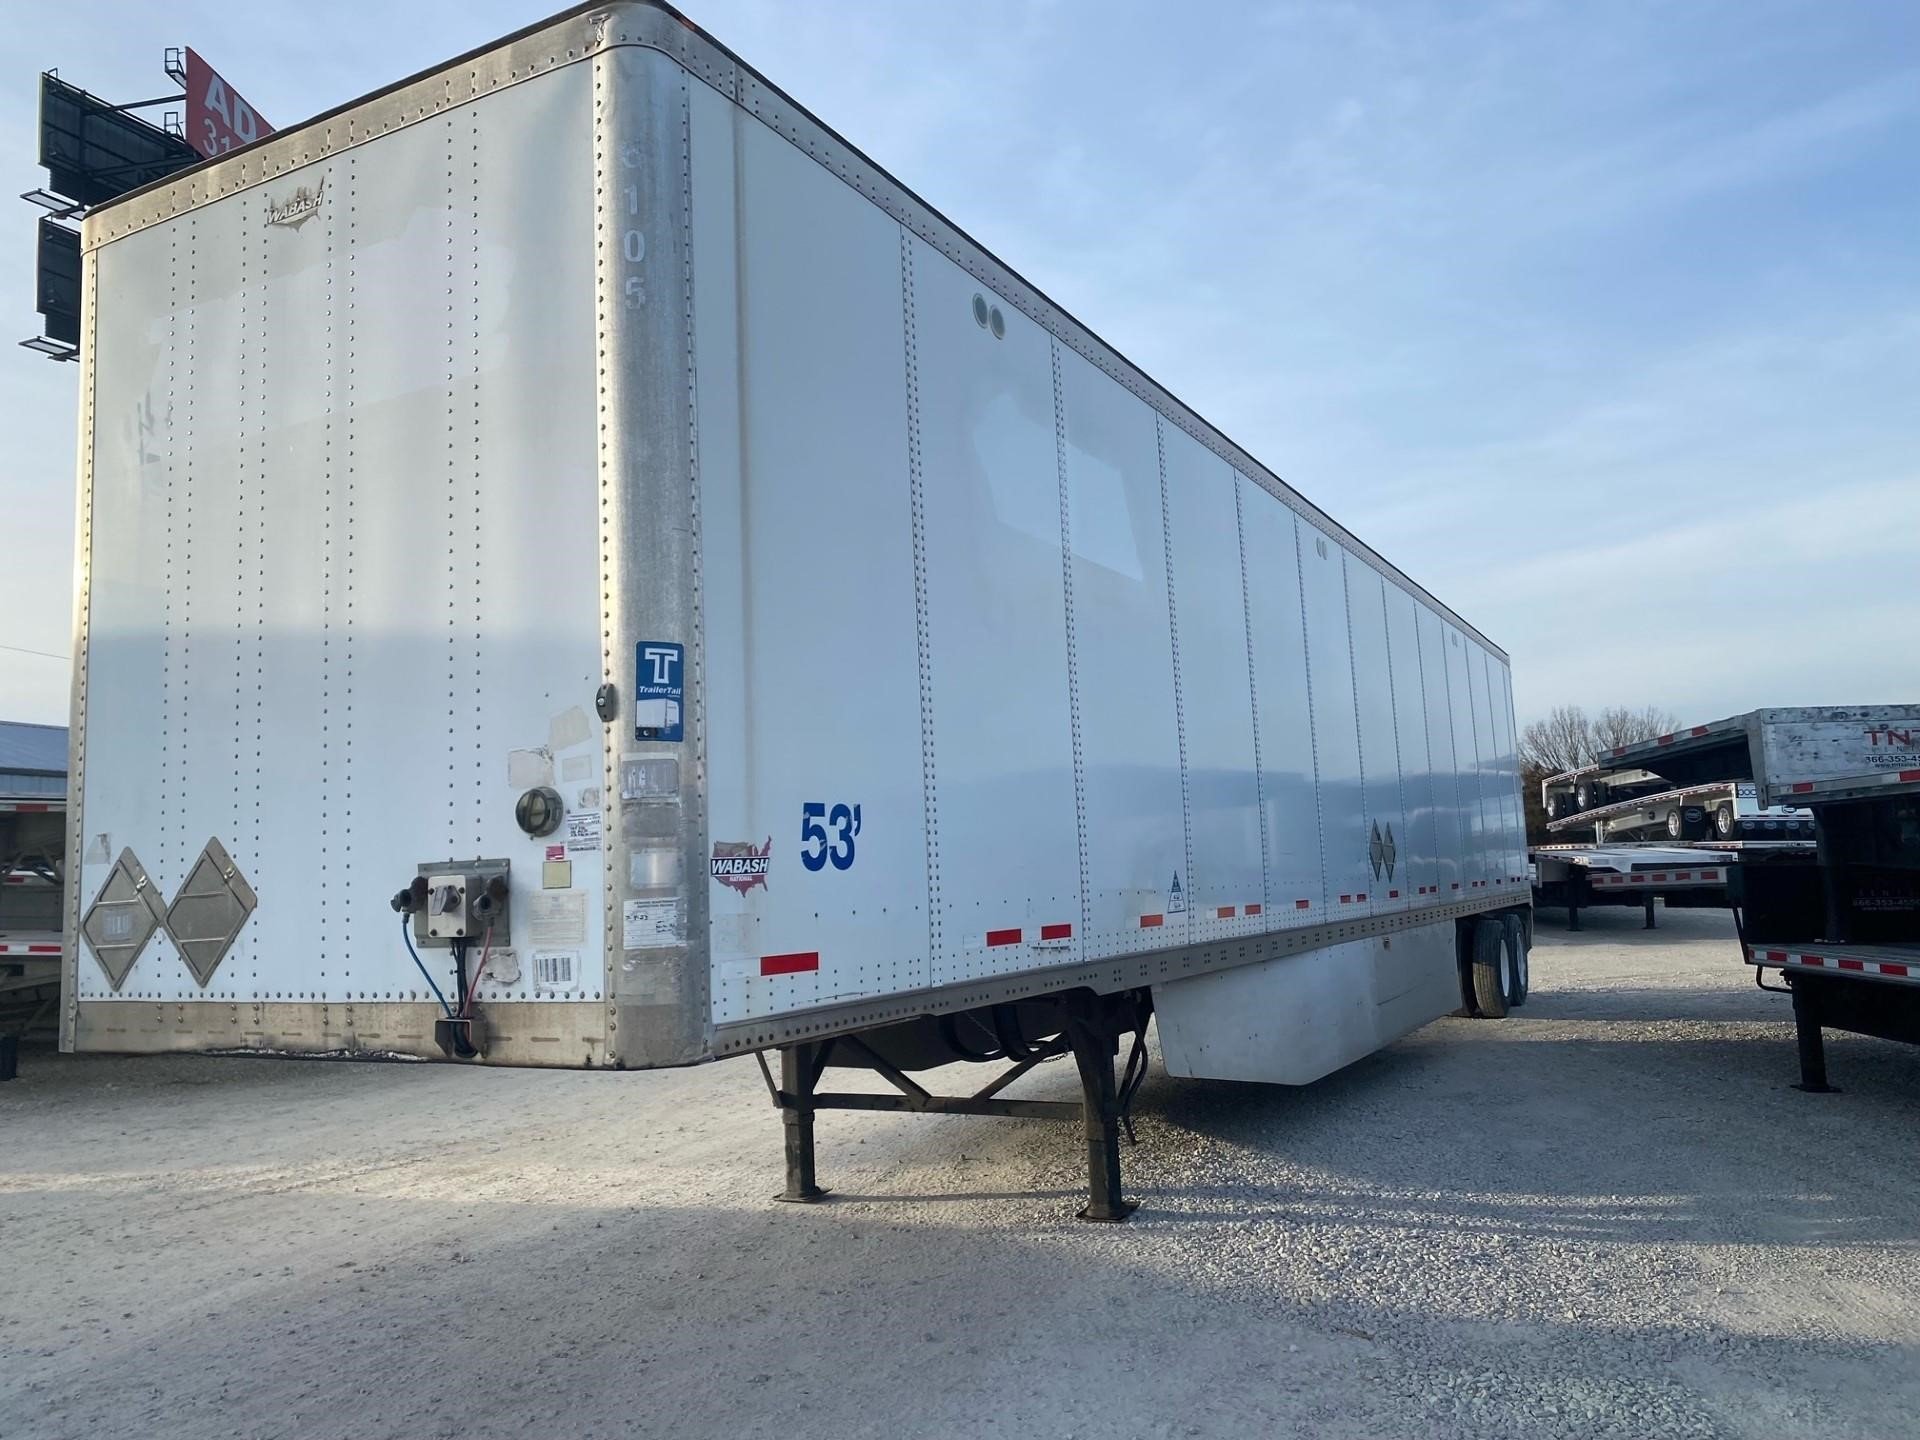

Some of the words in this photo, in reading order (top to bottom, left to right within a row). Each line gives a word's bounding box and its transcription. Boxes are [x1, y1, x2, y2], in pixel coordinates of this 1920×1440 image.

[204, 72, 257, 145] AD
[267, 190, 324, 224] WABASH
[640, 685, 682, 696] TrailerTail
[801, 802, 861, 872] 53'
[711, 858, 769, 875] WABASH
